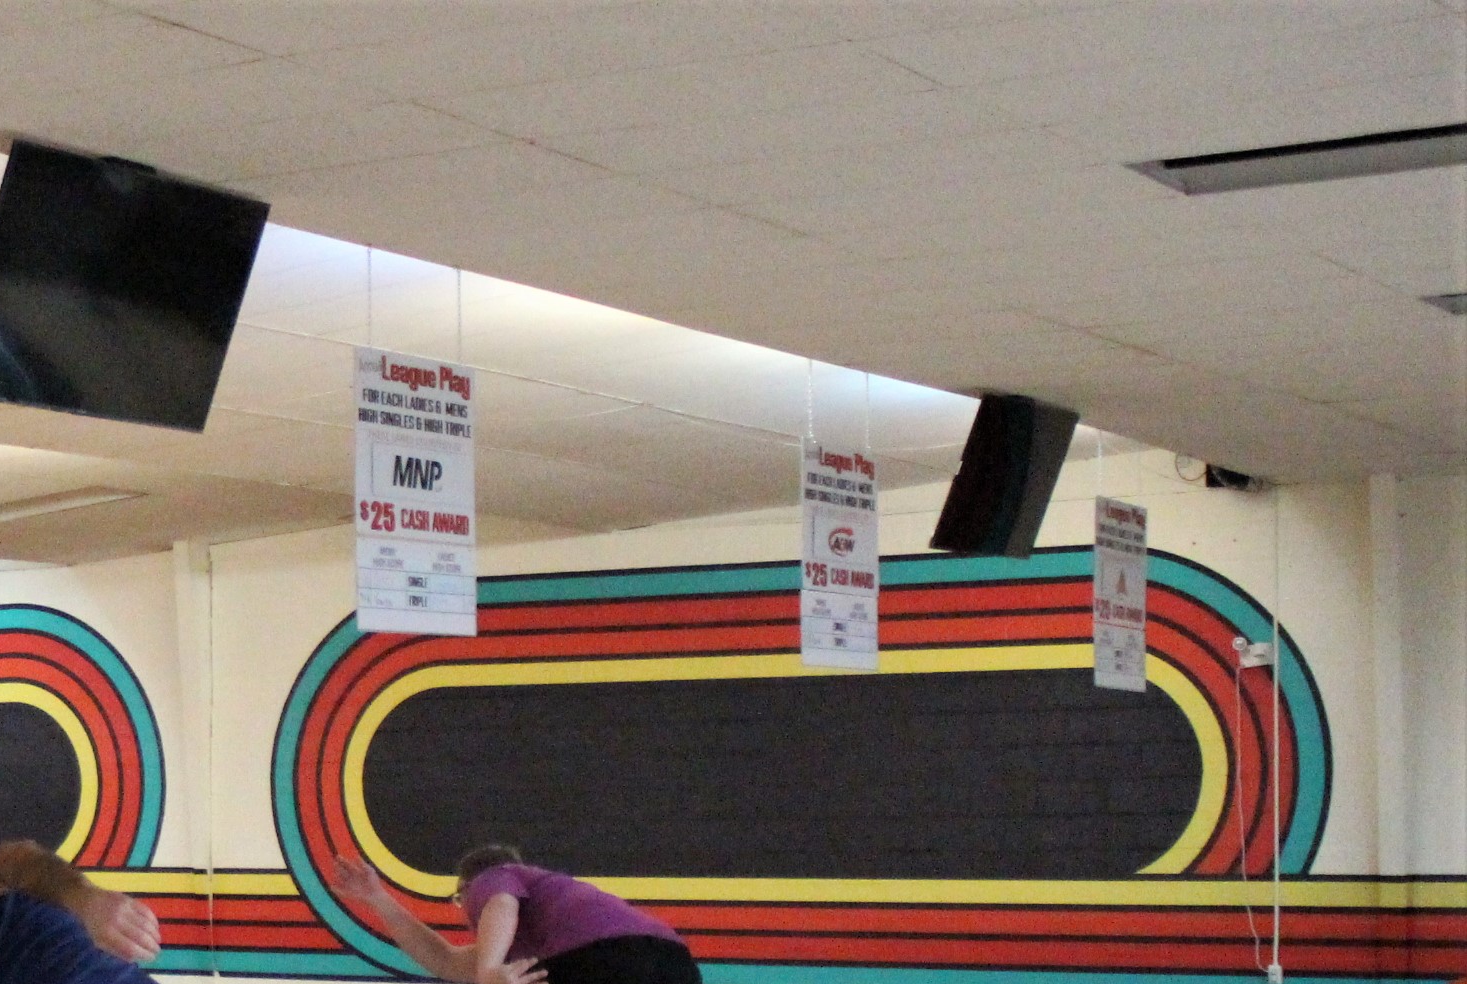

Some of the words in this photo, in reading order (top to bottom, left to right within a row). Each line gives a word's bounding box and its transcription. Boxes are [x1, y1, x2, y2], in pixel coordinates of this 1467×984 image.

[381, 354, 436, 391] League
[439, 366, 470, 401] Play
[363, 388, 379, 404] FOR
[381, 391, 403, 409] EACH
[405, 396, 434, 412] LADIES
[445, 402, 468, 418] MENS
[358, 407, 378, 424] HIGH
[380, 411, 414, 429] SINGLES
[424, 418, 443, 434] HIGH
[445, 421, 472, 439] TRIPLE
[393, 455, 443, 490] MNP
[401, 508, 430, 532] CASH
[432, 512, 469, 536] AWARD
